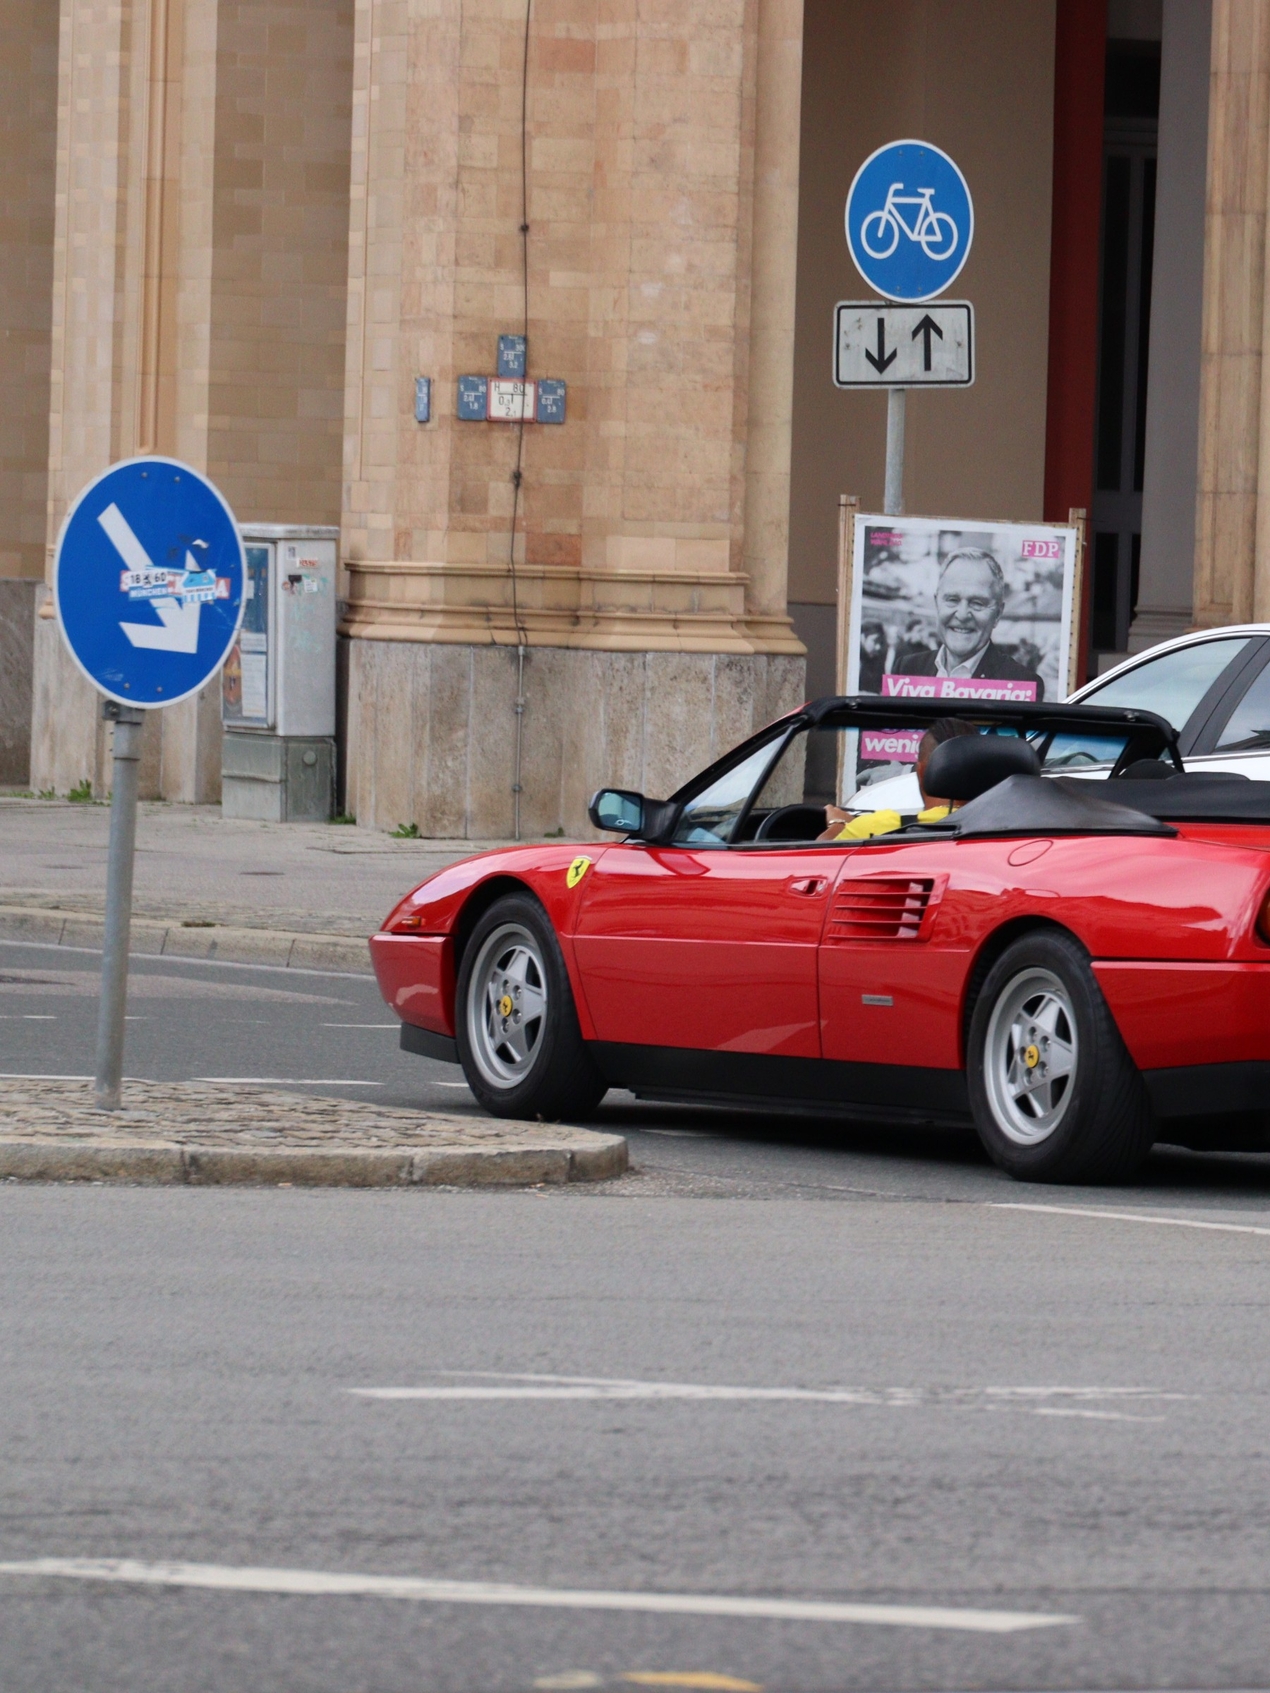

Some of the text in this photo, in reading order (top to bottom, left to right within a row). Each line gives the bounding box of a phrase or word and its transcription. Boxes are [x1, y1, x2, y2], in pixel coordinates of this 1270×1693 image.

[494, 381, 500, 391] H
[1023, 541, 1059, 557] FDP
[887, 677, 935, 697] Viva
